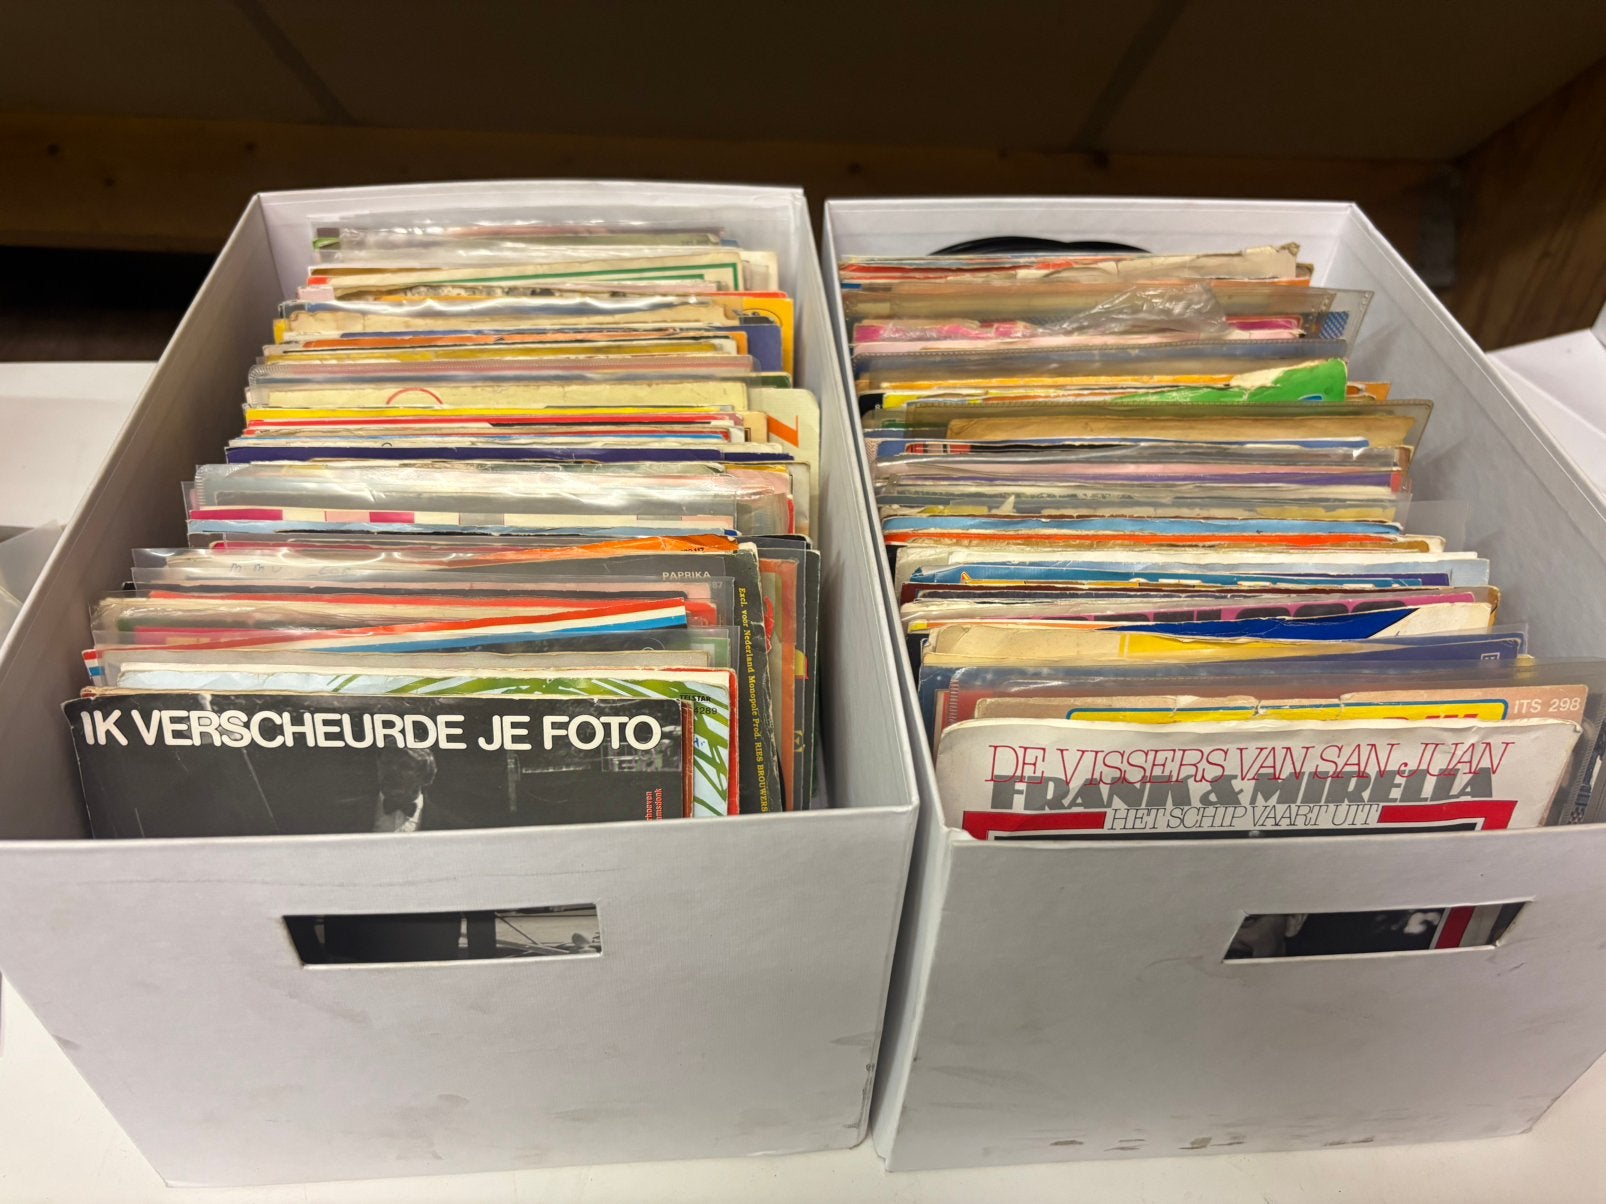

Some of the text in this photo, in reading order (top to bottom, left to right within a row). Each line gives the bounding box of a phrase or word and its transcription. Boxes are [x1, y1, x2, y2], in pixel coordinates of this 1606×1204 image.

[662, 571, 711, 581] PAPRIKA
[738, 587, 769, 812] Excl. voor Nederland Monopole Prod. RIES BROUWERS
[1513, 697, 1581, 714] ITS 298
[80, 709, 662, 751] IK VERSCHEURDE JE FOTO
[984, 740, 1516, 786] DE VISSERS VAN SAN JUAN
[990, 766, 1493, 811] FRANK & MIRELLA
[1107, 802, 1381, 831] HET SCHIP VAART UIT
